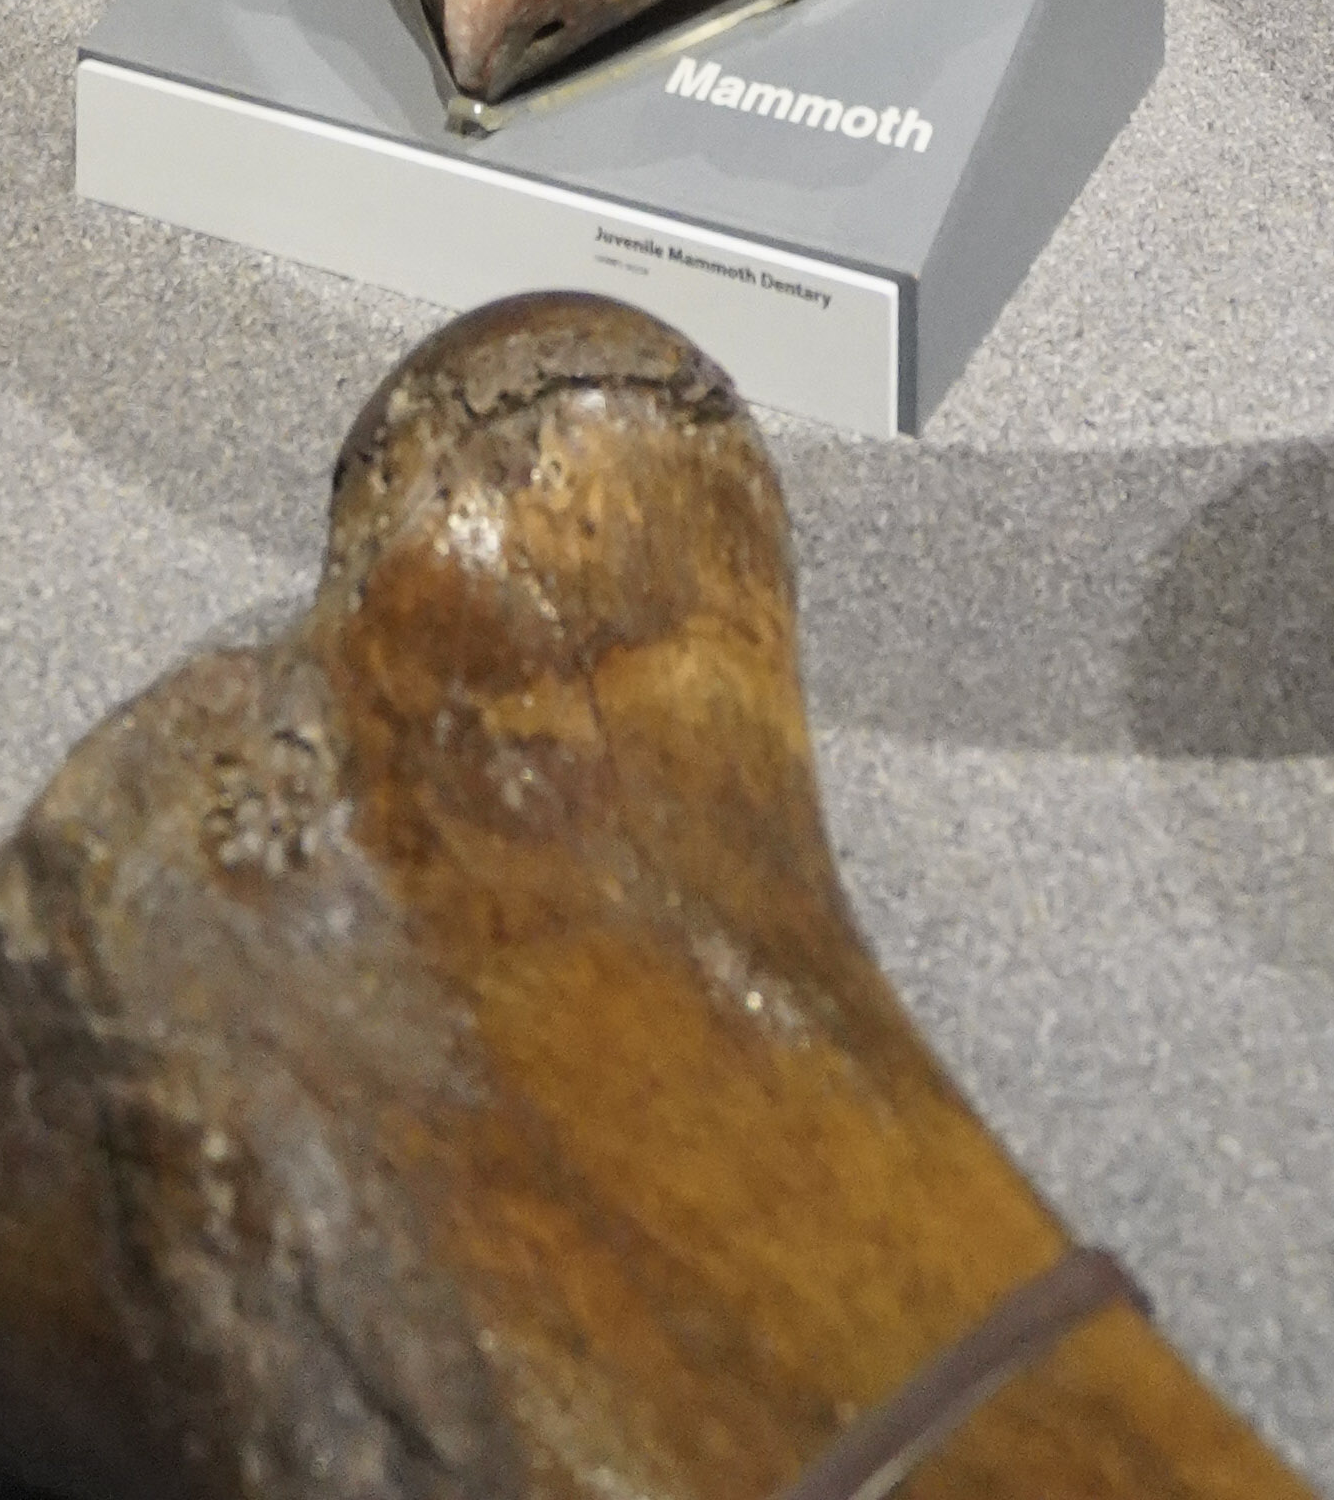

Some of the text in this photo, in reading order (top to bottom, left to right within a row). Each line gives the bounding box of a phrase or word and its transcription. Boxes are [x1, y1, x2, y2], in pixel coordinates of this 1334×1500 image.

[664, 55, 934, 153] Mammoth
[595, 226, 663, 259] Juvenile
[668, 246, 757, 285] Mammoth
[761, 271, 832, 310] Dentary
